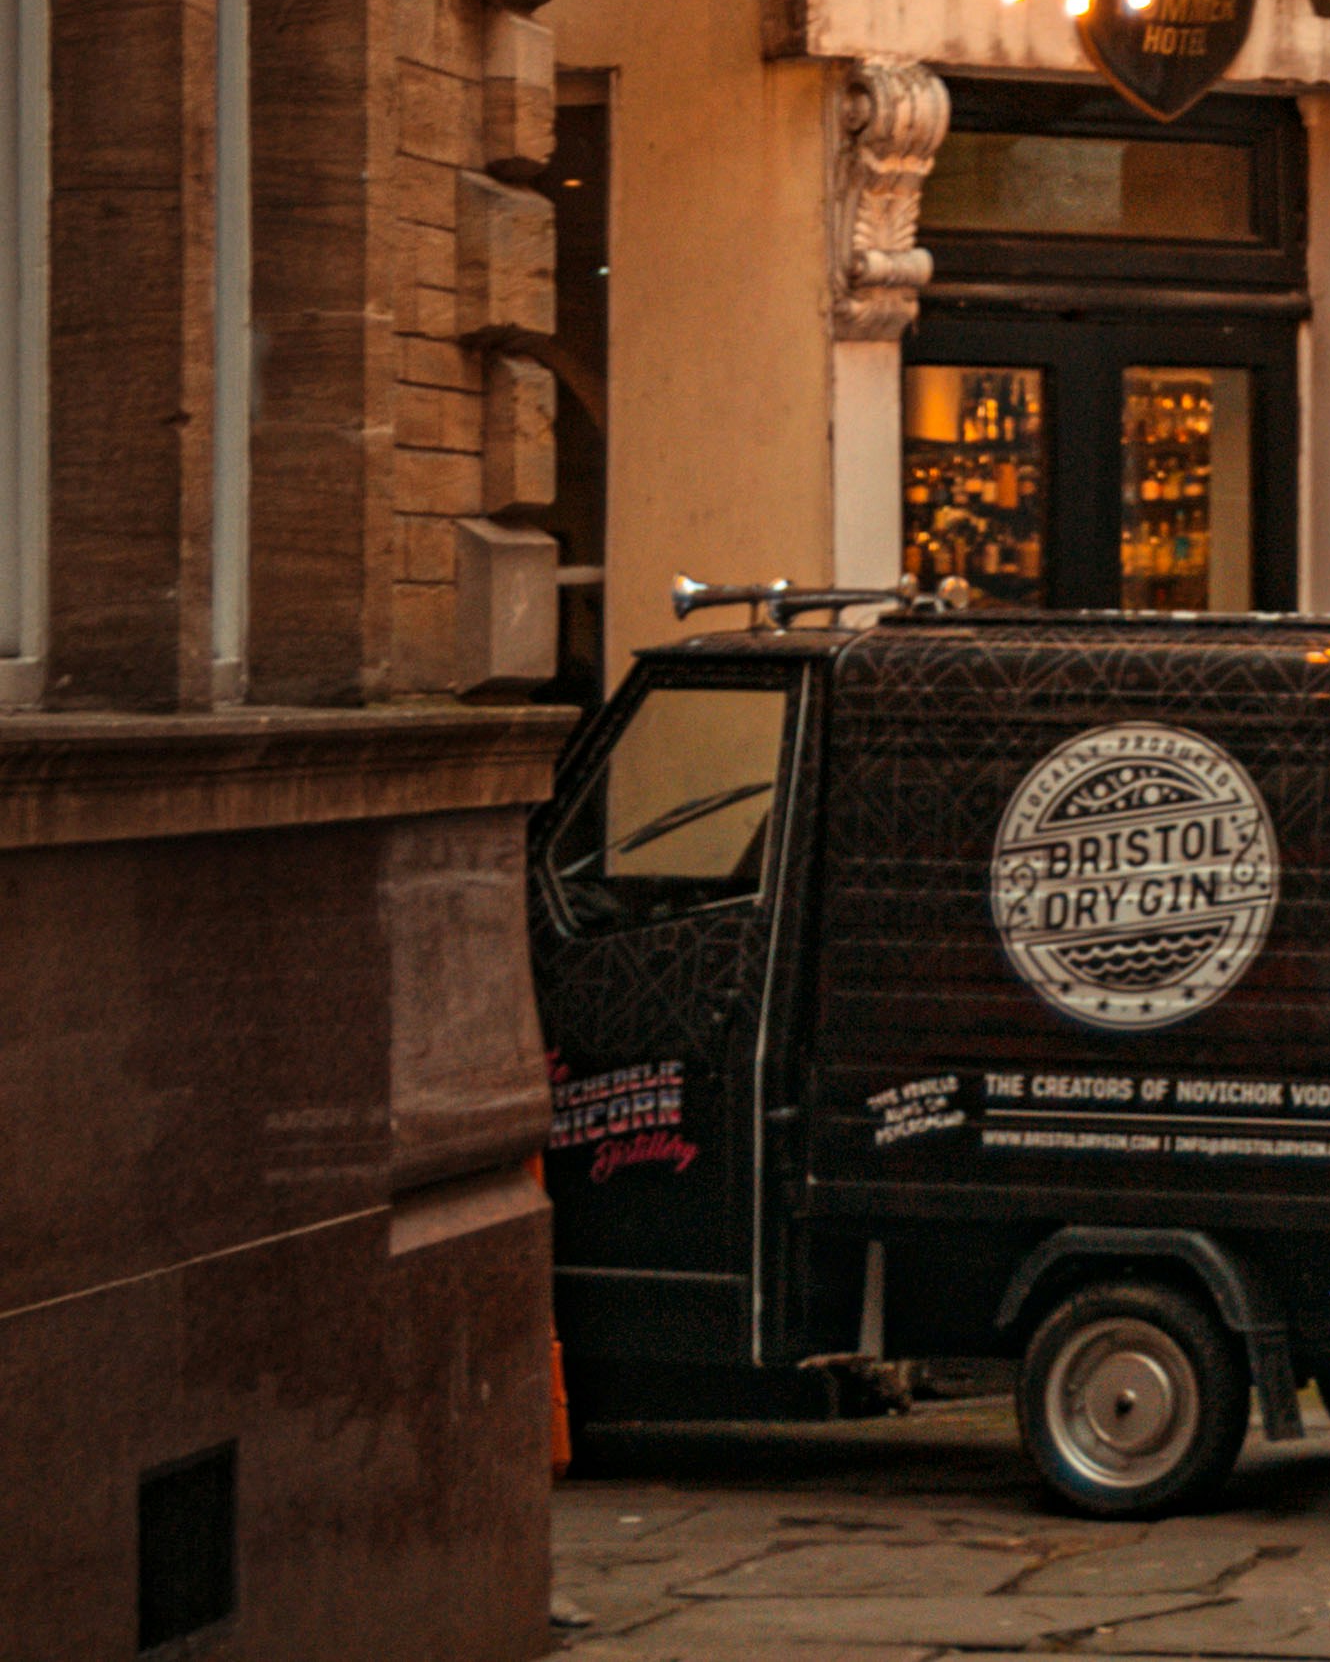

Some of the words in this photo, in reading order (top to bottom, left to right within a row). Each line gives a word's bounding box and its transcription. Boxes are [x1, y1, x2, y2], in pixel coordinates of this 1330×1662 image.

[1047, 816, 1232, 880] BRISTOL
[986, 1074, 1024, 1097] THE
[1032, 1076, 1134, 1102] CREATORS
[1141, 1078, 1170, 1102] OF
[1176, 1080, 1284, 1106] NOVICHOK
